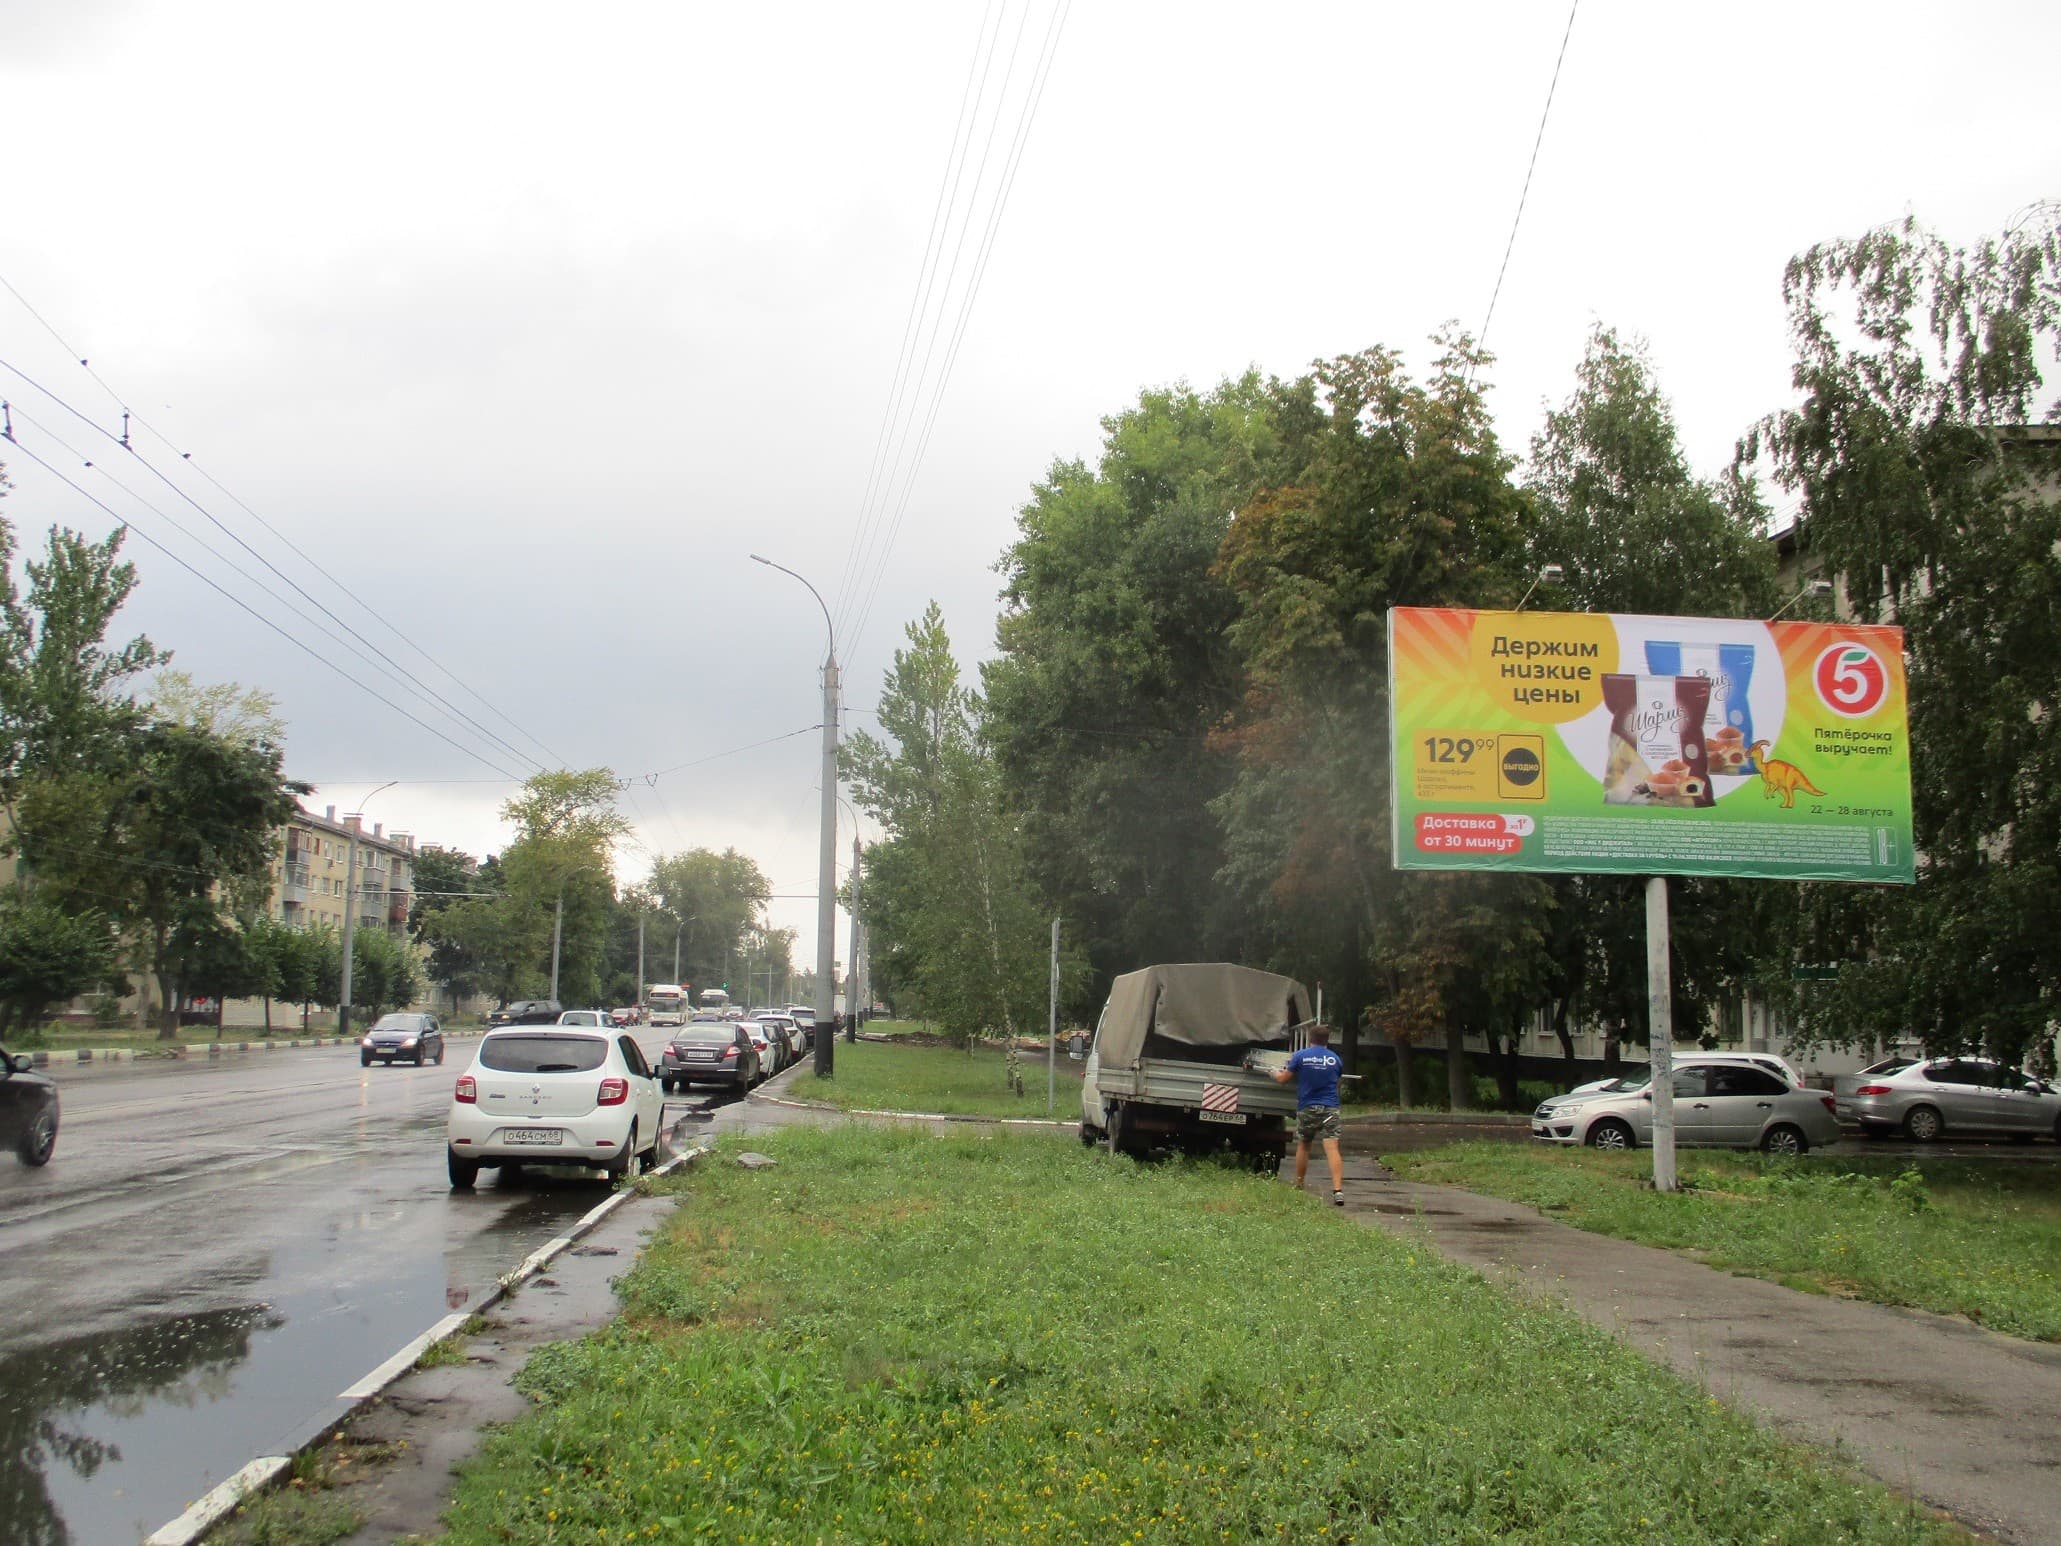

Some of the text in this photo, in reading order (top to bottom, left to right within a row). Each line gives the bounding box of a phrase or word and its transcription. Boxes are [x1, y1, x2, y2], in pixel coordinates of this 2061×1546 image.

[1491, 636, 1598, 660] Держим
[1501, 663, 1592, 681] низкие
[1833, 649, 1870, 704] 5
[1514, 687, 1580, 705] цены
[1814, 727, 1892, 742] Пятёрочка
[1815, 743, 1892, 756] выручает!
[1810, 804, 1823, 814] 22
[1838, 806, 1850, 815] 28
[1852, 808, 1894, 818] августа
[1423, 816, 1497, 830] Доставка
[1424, 835, 1514, 851] от 30 минут
